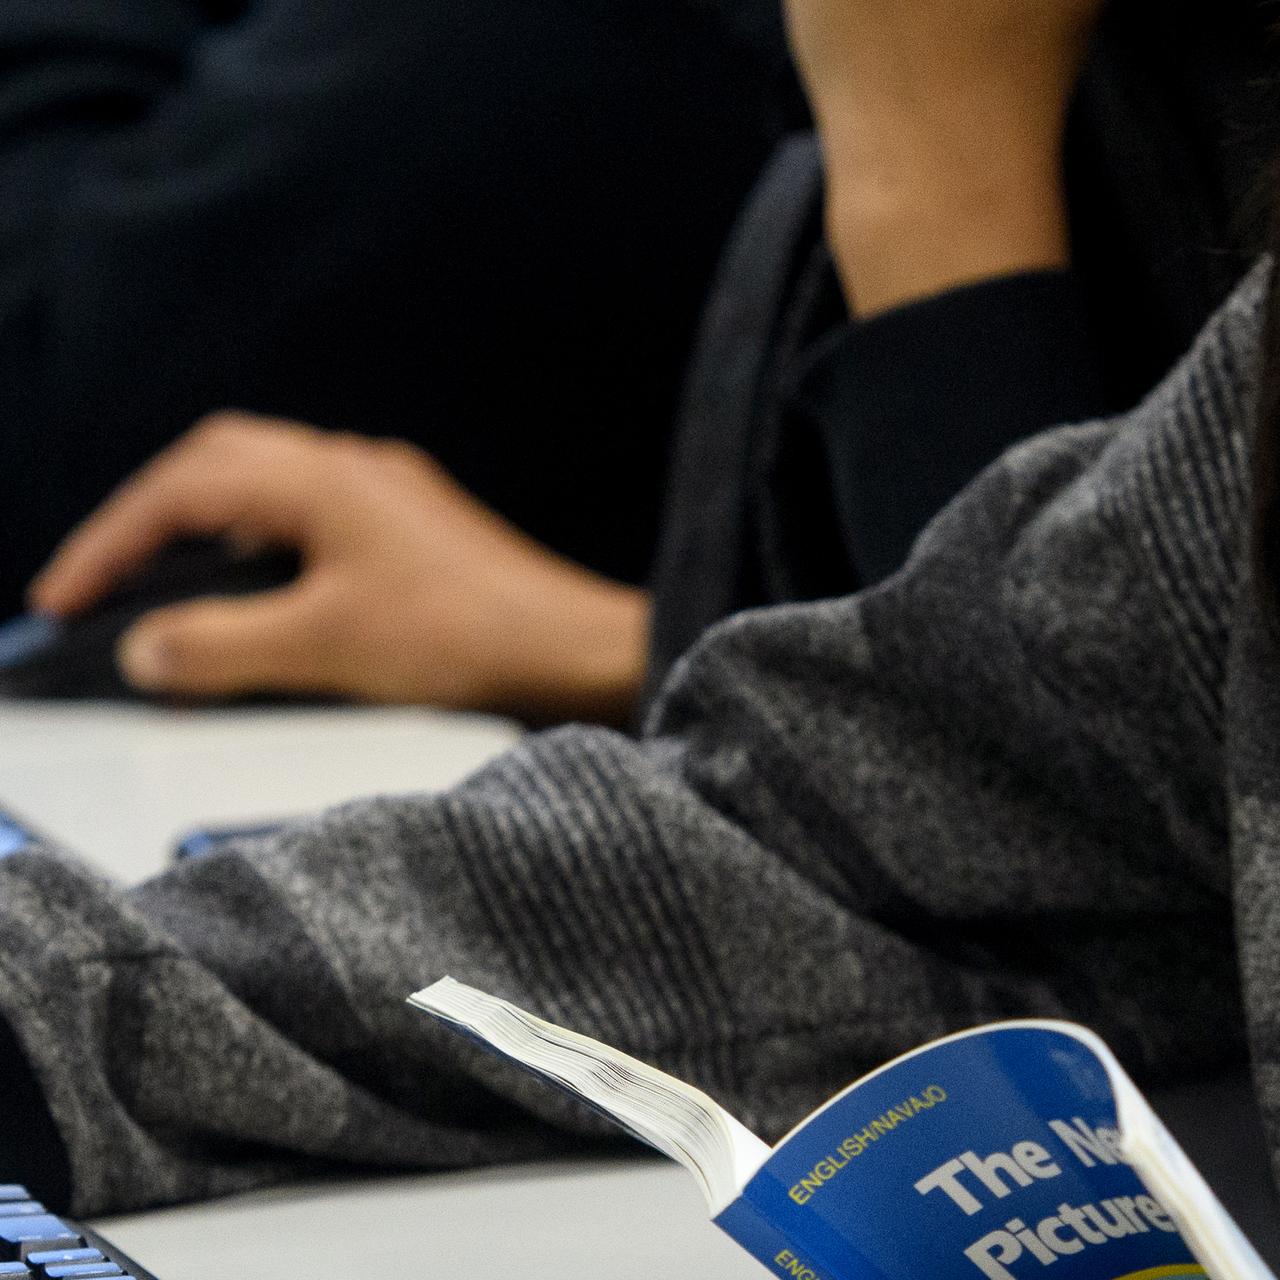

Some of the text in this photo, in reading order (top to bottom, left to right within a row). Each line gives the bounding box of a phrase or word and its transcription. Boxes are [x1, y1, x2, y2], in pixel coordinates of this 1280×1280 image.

[787, 1084, 949, 1206] ENGLISH/NAVAJO
[914, 1116, 1124, 1217] The Ne
